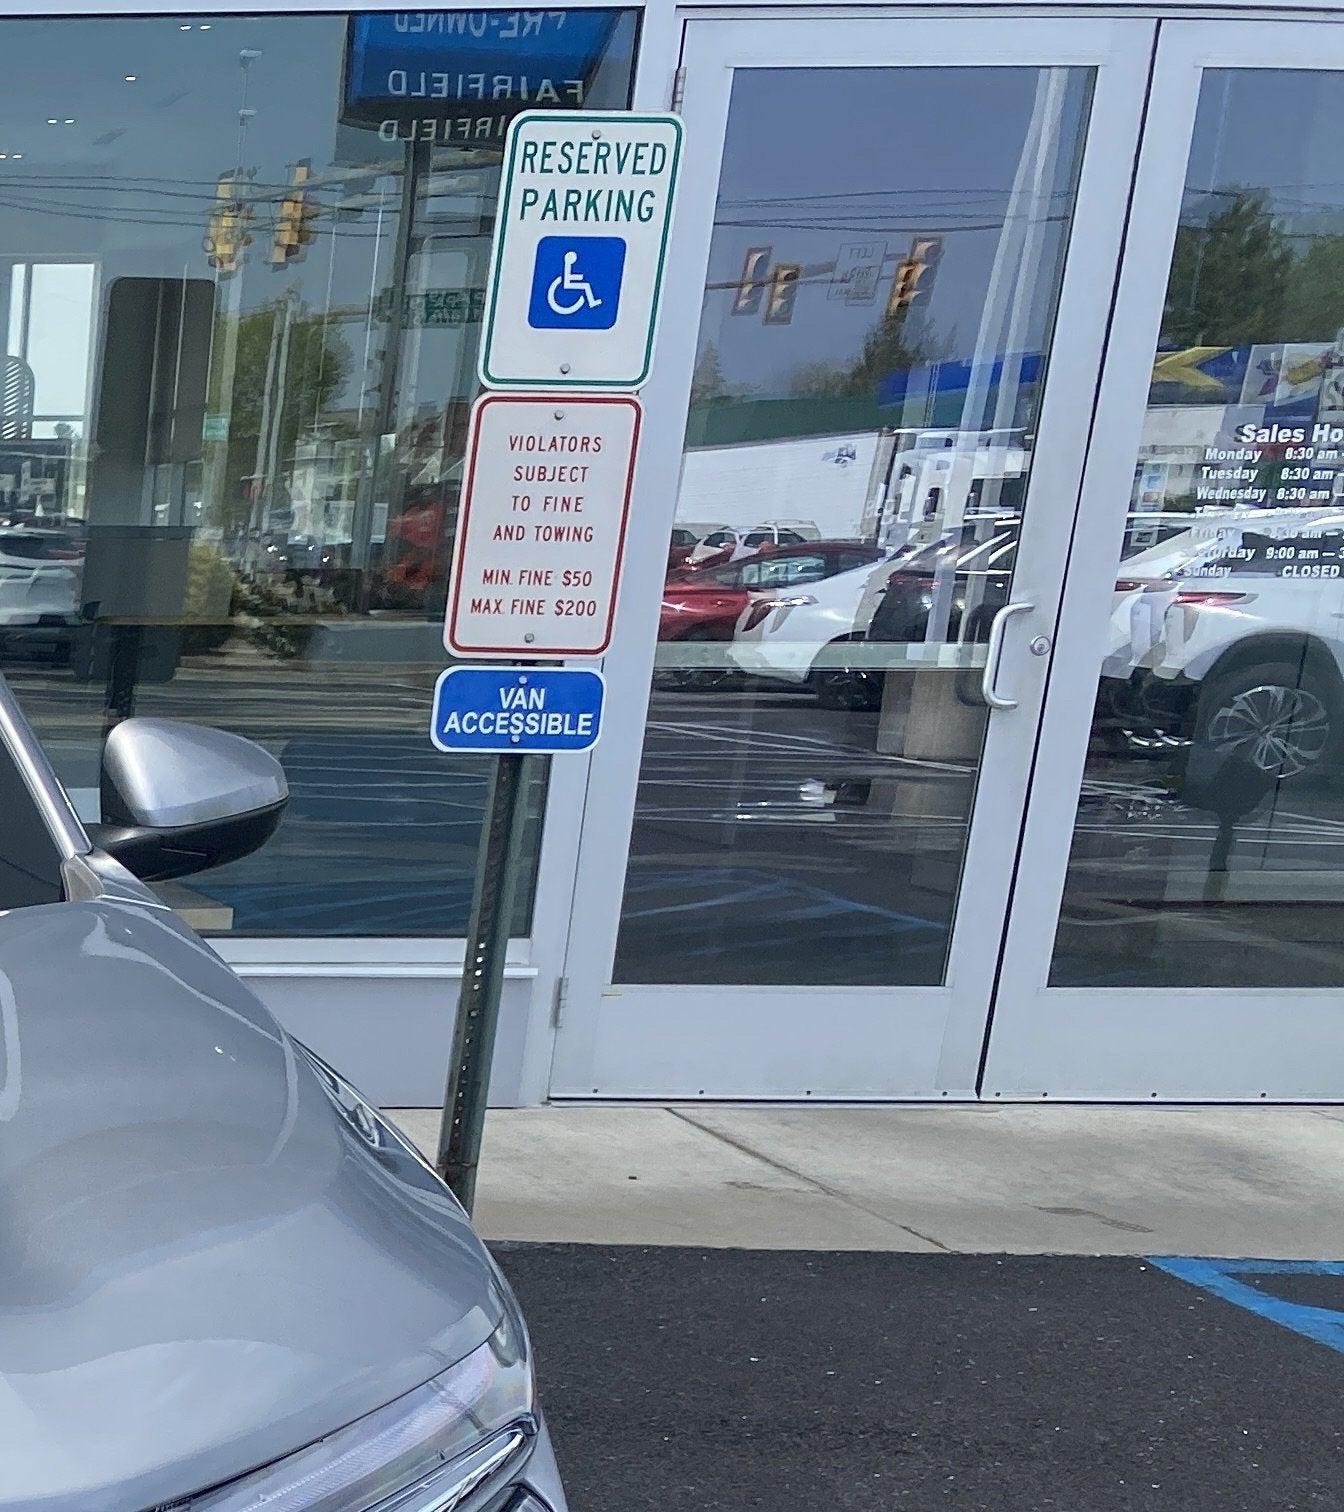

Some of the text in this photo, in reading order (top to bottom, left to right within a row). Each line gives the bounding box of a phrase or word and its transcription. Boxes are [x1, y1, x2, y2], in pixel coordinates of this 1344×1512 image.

[520, 141, 667, 176] RESERVED
[519, 188, 656, 223] PARKING
[1240, 423, 1305, 443] Sales
[508, 435, 603, 453] VIOLATORS
[1204, 447, 1262, 463] Monday
[1284, 447, 1314, 460] 8:30
[1316, 450, 1338, 460] am
[513, 465, 590, 483] SUBJECT
[1201, 466, 1334, 482] Tuesday 8:30 am
[1196, 486, 1330, 502] Wednesday 8:30 am
[511, 495, 584, 513] TO FINE
[492, 524, 595, 543] AND TOWING
[1265, 546, 1295, 559] 9:00
[1297, 549, 1319, 559] am
[519, 570, 553, 586] FINE
[562, 569, 592, 587] $50
[1184, 564, 1341, 579] Sunday CLOSED
[511, 599, 545, 616] FINE
[554, 599, 597, 617] $200
[499, 687, 546, 710] VAN
[442, 711, 594, 736] ACCESSIBLE
